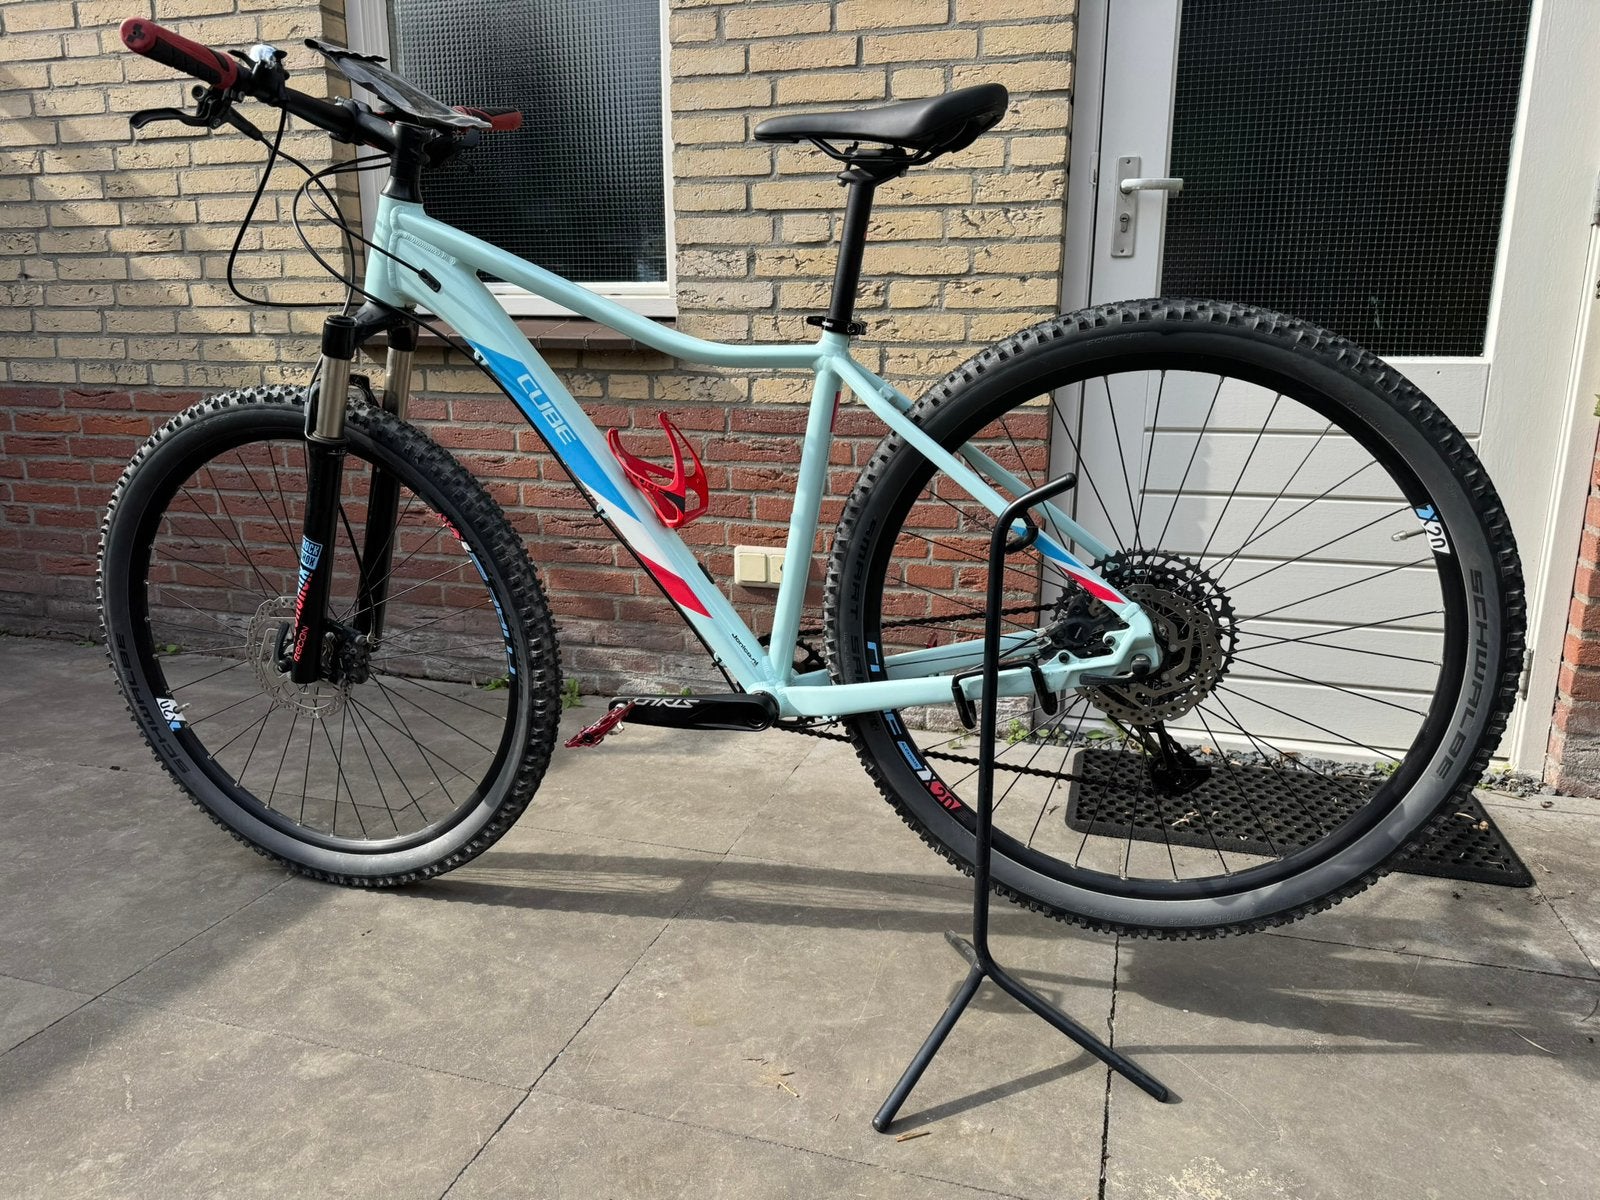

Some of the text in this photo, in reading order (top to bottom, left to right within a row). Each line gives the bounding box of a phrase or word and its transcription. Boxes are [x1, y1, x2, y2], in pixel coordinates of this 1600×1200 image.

[517, 373, 577, 446] CUBE
[115, 632, 190, 774] SCHWALBE
[1436, 568, 1488, 780] SCHWALBE
